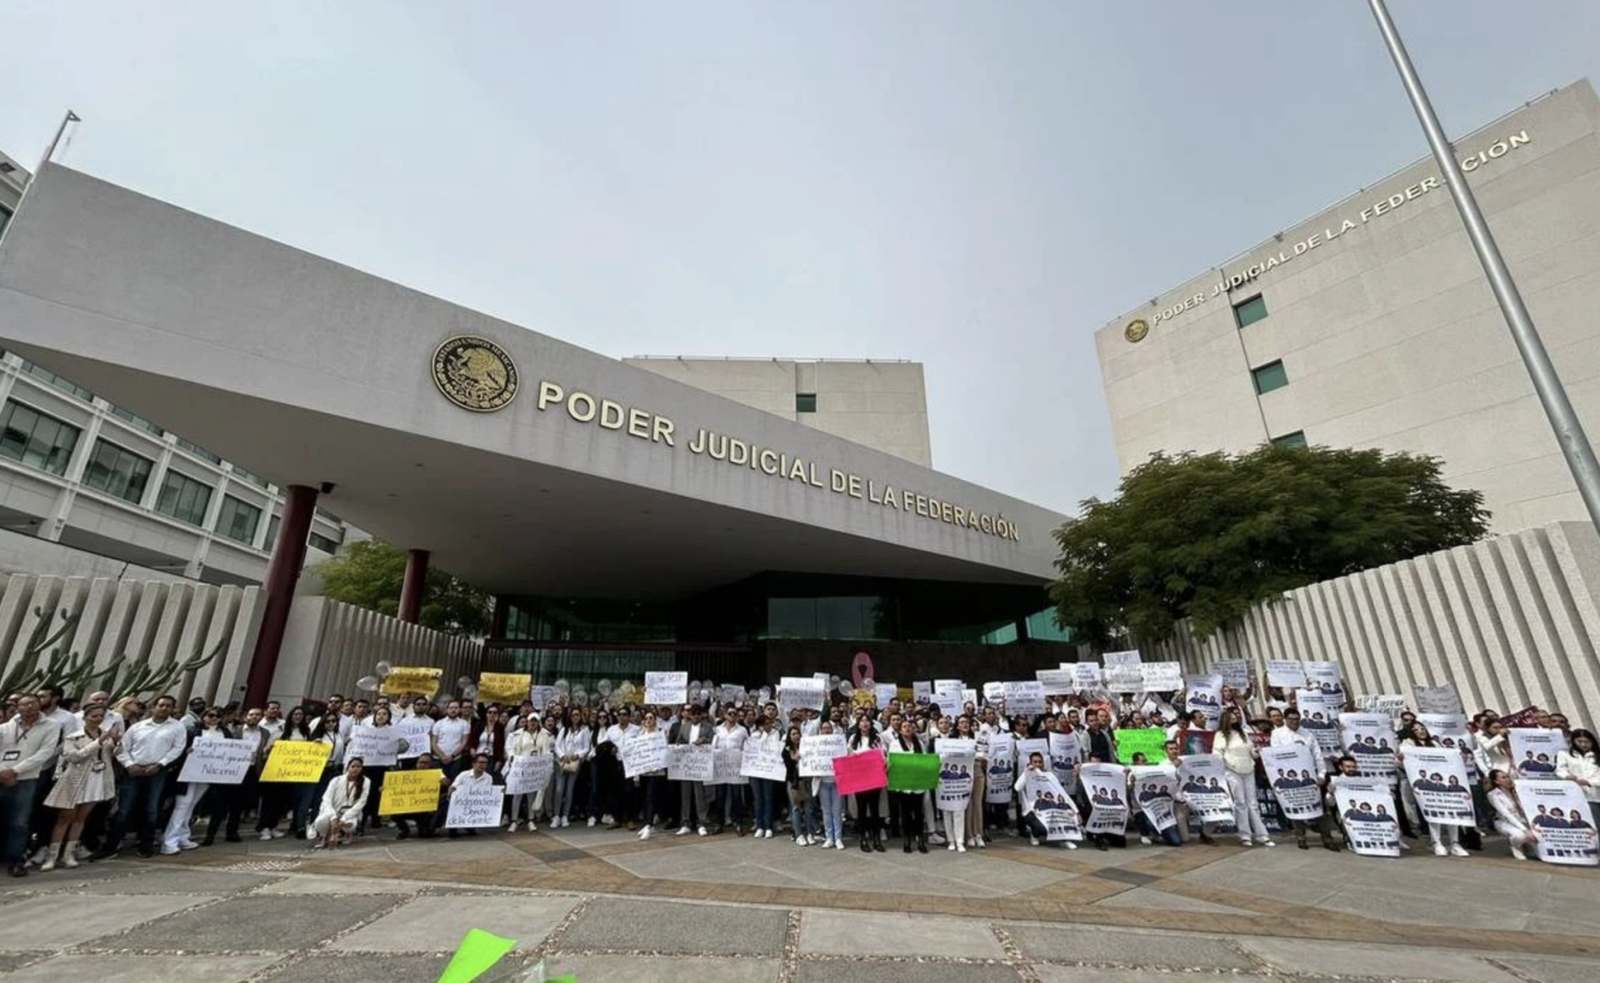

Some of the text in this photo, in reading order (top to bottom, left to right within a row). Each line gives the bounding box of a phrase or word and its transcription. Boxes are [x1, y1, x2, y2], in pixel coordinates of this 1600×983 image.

[1152, 130, 1530, 325] PODER JUDICIAL DE LA FEDERCIÓN
[537, 380, 1020, 542] PODER JUDICIAL DE LA FEDERACIÓN
